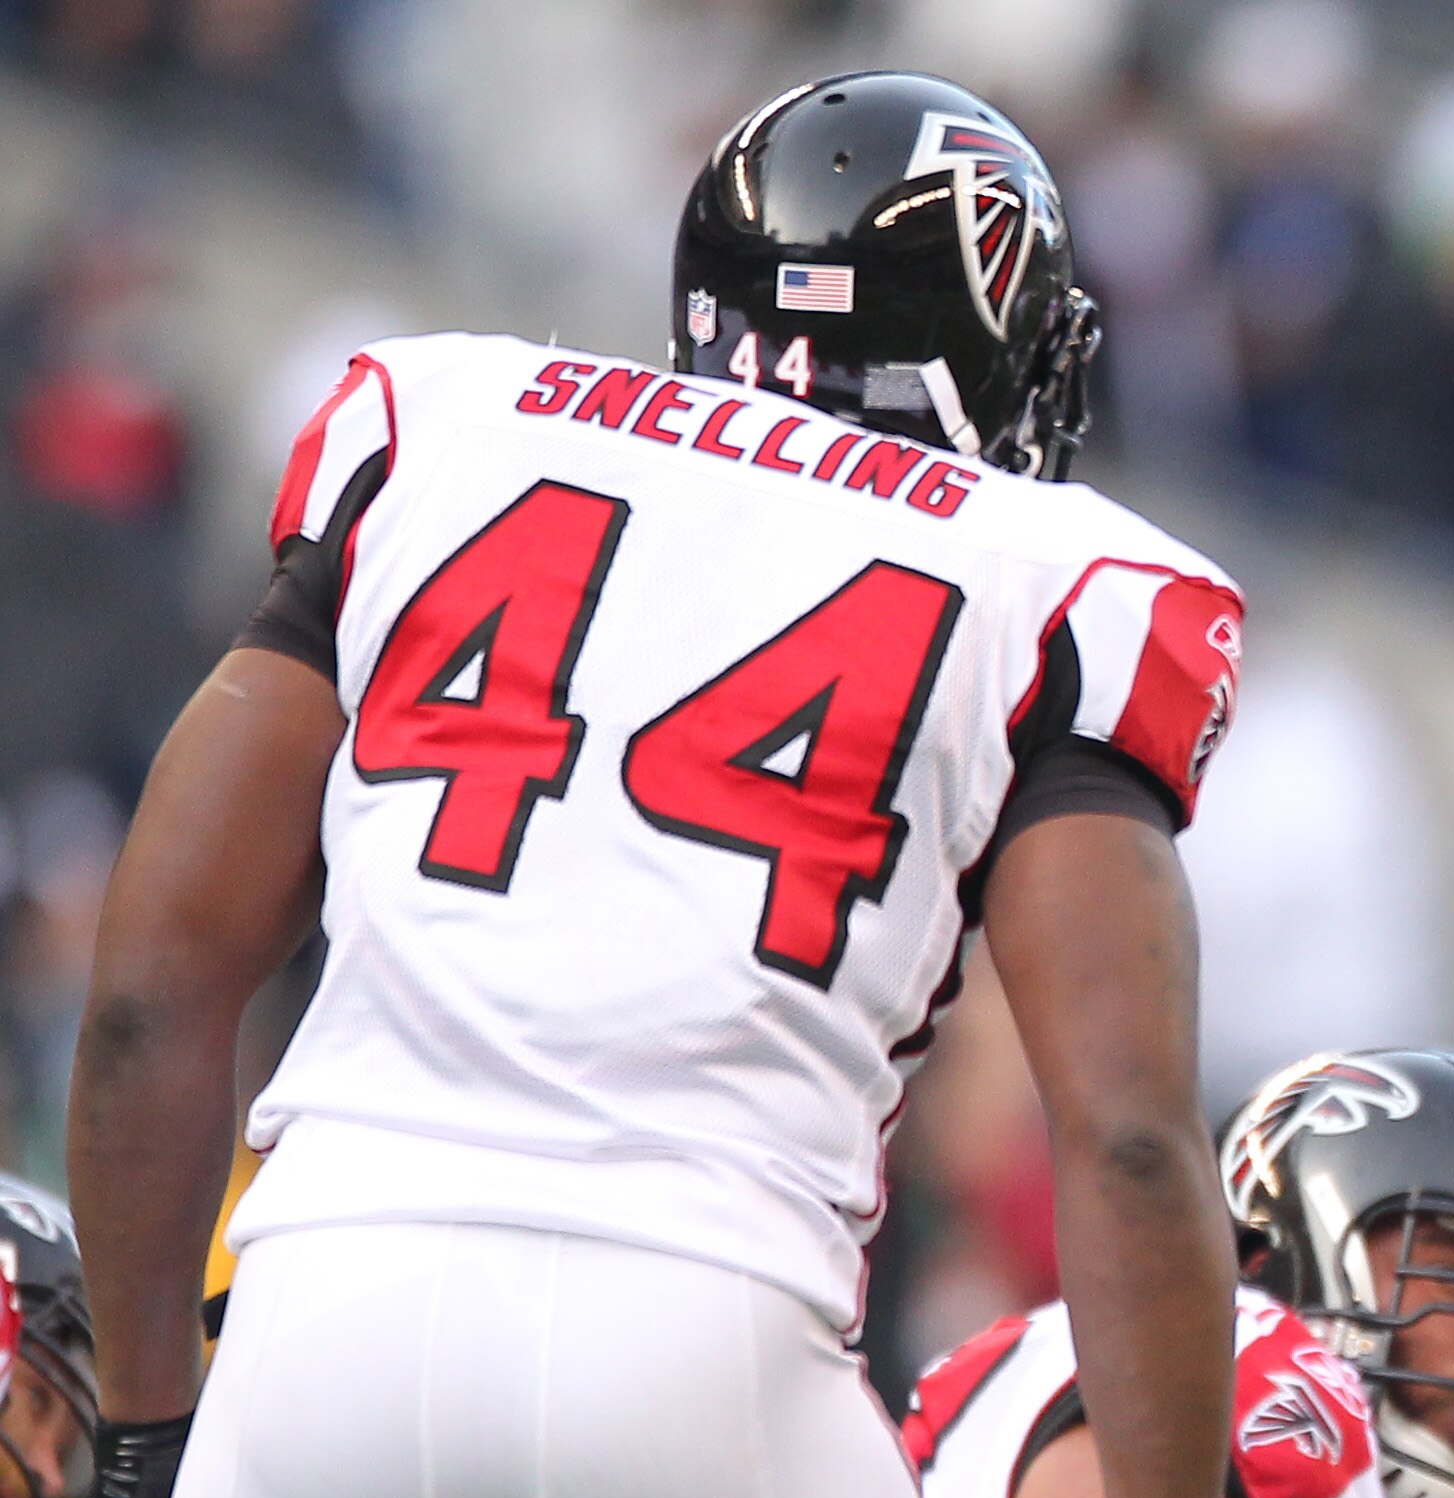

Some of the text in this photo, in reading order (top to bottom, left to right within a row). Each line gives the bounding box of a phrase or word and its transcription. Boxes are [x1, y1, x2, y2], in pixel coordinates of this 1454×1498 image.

[515, 360, 981, 519] SNELLING
[728, 331, 814, 398] 44
[352, 478, 967, 993] 44
